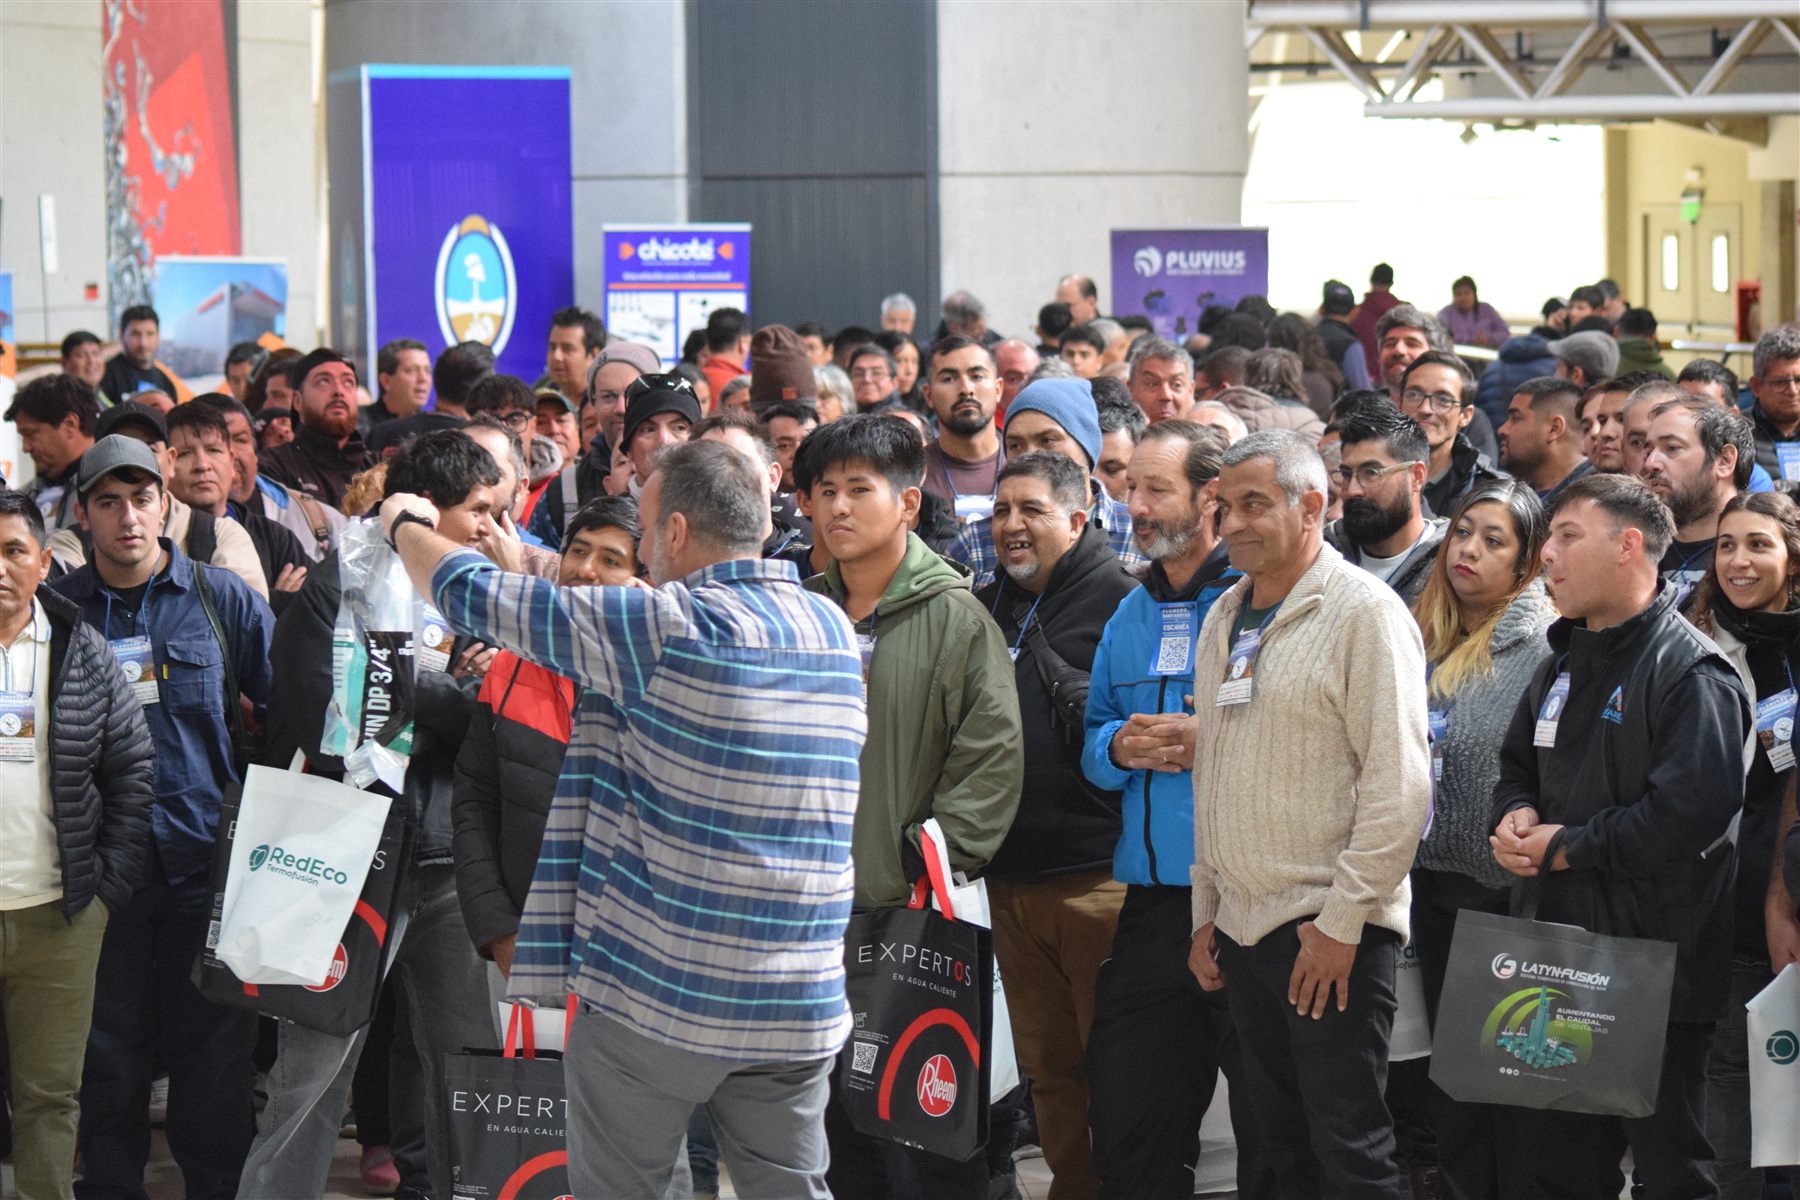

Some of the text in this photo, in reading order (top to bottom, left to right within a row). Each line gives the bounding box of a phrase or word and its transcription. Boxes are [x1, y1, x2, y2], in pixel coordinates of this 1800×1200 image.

[1165, 250, 1246, 269] PLUVIUS
[367, 686, 392, 711] DP
[266, 863, 319, 886] Termofusión
[269, 847, 348, 885] RedEco
[858, 942, 972, 986] EXPERTOS
[892, 972, 957, 998] EN AGUA CALIENTE
[1557, 1007, 1615, 1021] AUMENTANDO
[1567, 1015, 1601, 1026] CAUDAL
[1568, 1022, 1608, 1034] VENTAJAS
[919, 1056, 955, 1106] Rheem
[453, 1091, 568, 1119] EXPERT
[487, 1124, 567, 1137] EN AGUA CALIE
